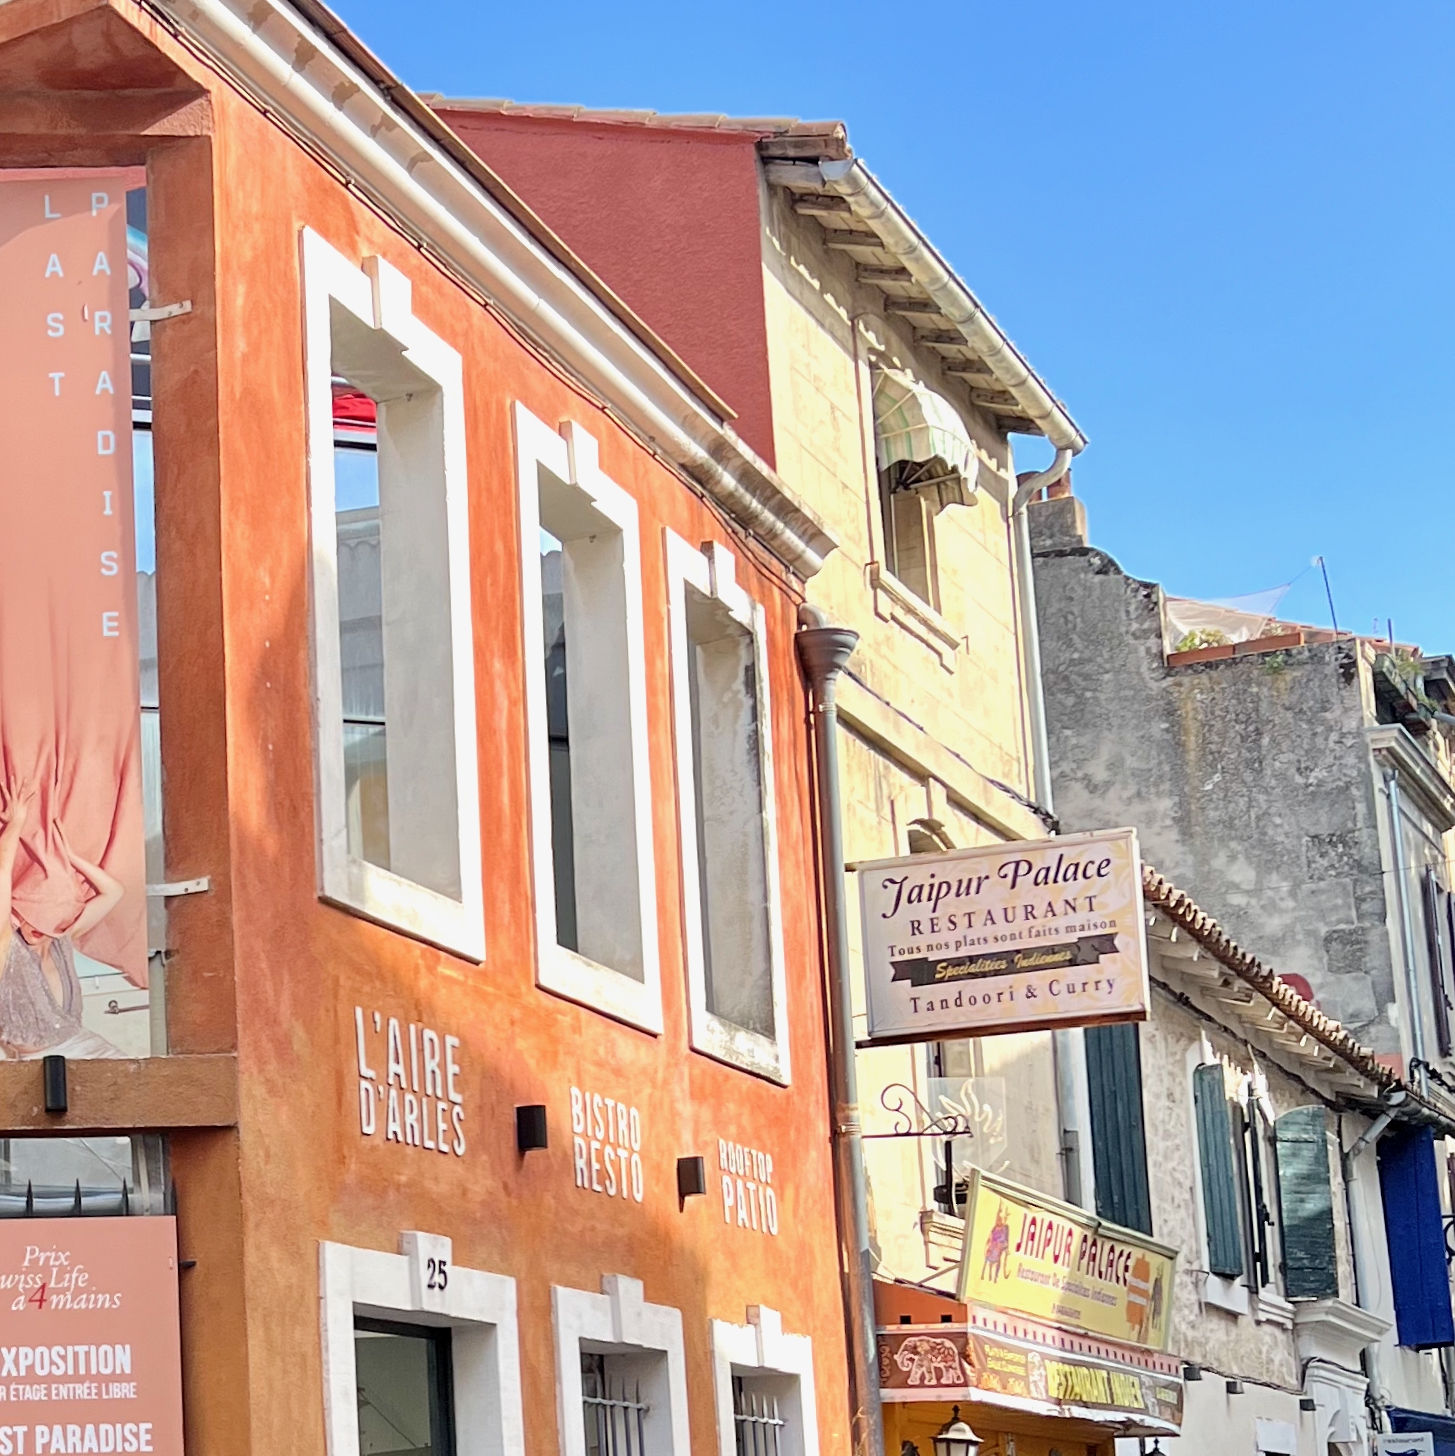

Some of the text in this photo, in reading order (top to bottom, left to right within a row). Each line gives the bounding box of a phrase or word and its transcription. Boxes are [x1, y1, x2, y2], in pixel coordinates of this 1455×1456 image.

[44, 194, 66, 397] LAST
[90, 192, 120, 638] PARADISE
[882, 853, 1111, 919] Jaipur Palace
[888, 919, 1117, 957] Tous nos plats sont faits maison
[909, 895, 1097, 936] RESTAURANT
[910, 978, 1116, 1014] Tandoori & Curry
[354, 1006, 463, 1105] L'AIRE
[359, 1080, 466, 1157] D'ARLES
[569, 1086, 641, 1152] BISTRO
[573, 1139, 644, 1203] RESTO
[718, 1138, 774, 1179] ROOFTOP
[722, 1176, 778, 1235] PATIO
[22, 1245, 71, 1267] Prix
[426, 1258, 448, 1291] 25
[1015, 1213, 1132, 1287] JAIPUR PALACE
[28, 1282, 48, 1310] 4
[49, 1289, 122, 1310] mains
[10, 1380, 48, 1401] ÉTAGE
[51, 1379, 99, 1400] ENTRÉE
[102, 1380, 137, 1399] LIBRE
[35, 1422, 153, 1454] PARADISE
